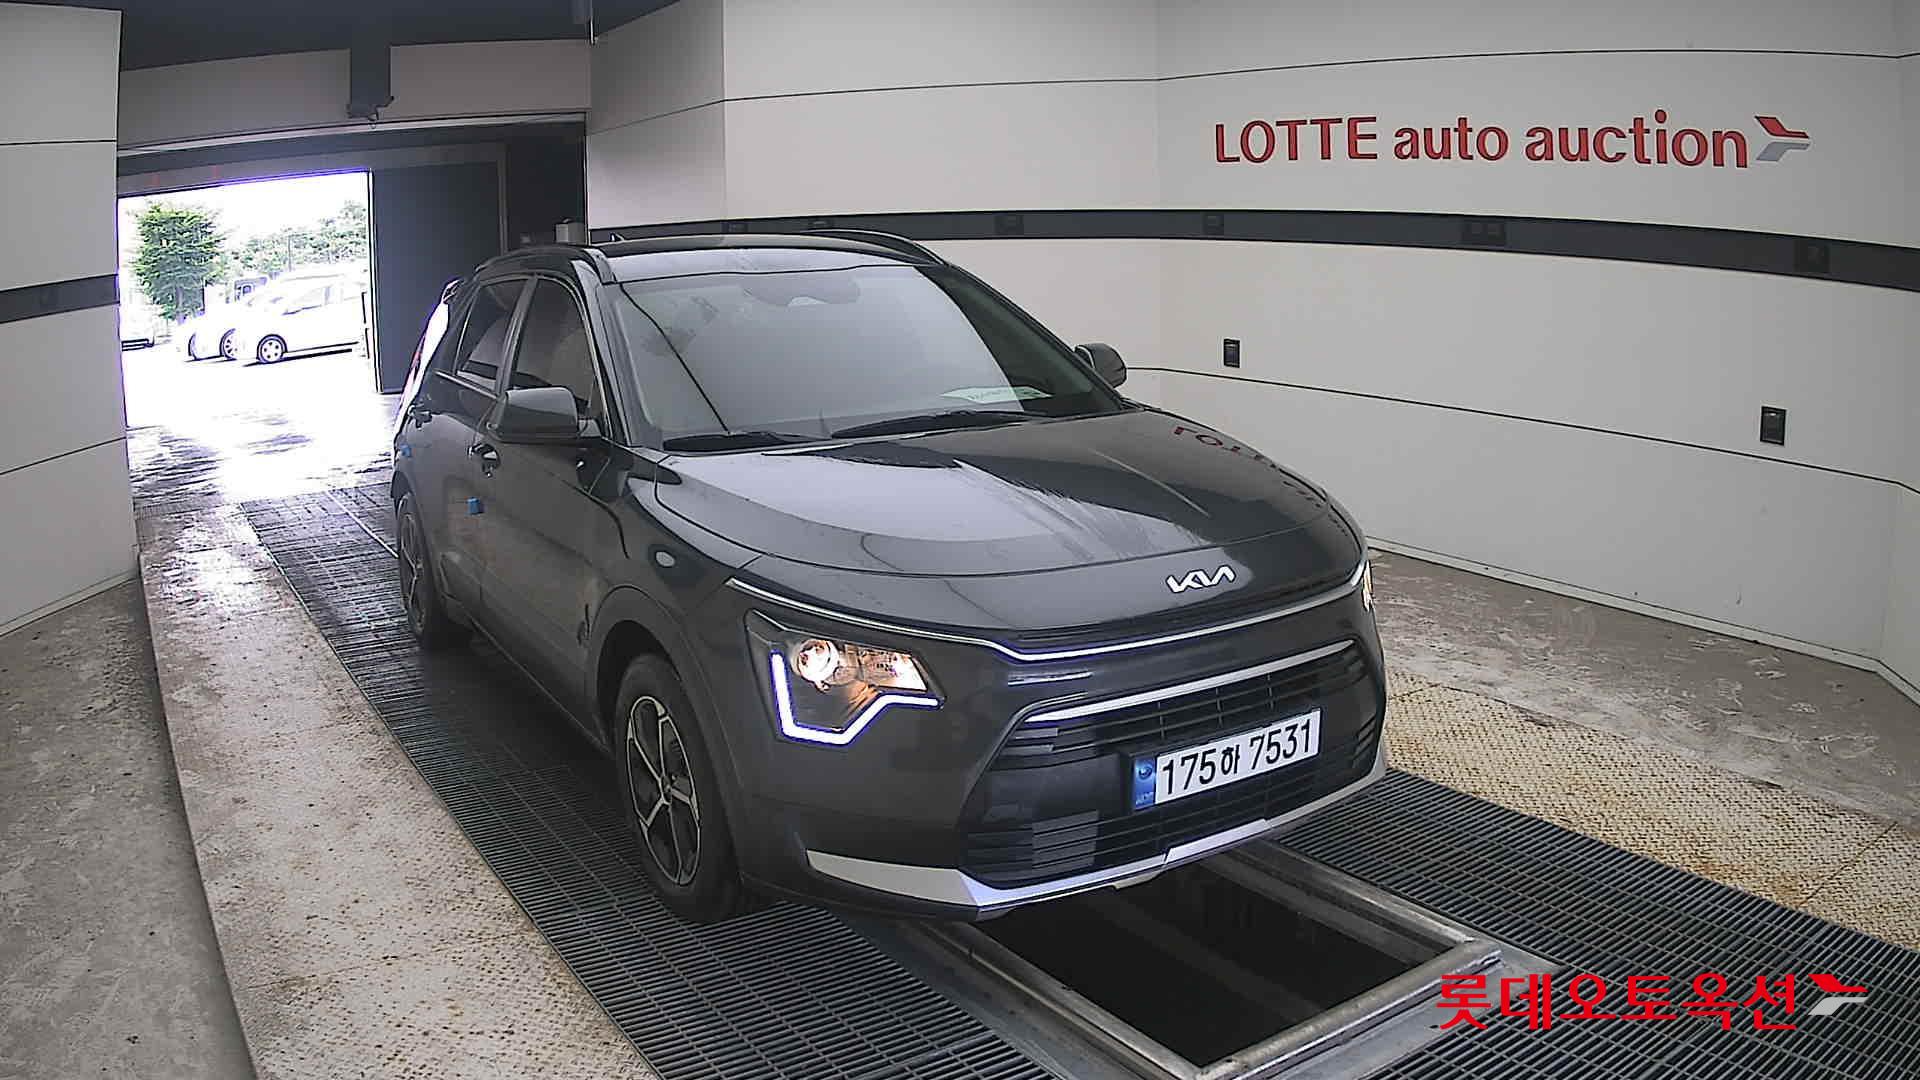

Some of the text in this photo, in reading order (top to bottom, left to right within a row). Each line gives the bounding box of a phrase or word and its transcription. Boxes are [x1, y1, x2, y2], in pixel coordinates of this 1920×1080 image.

[1215, 109, 1748, 168] LOTTE auto auction
[1166, 564, 1236, 593] KIA
[1162, 718, 1312, 795] 175하 7531
